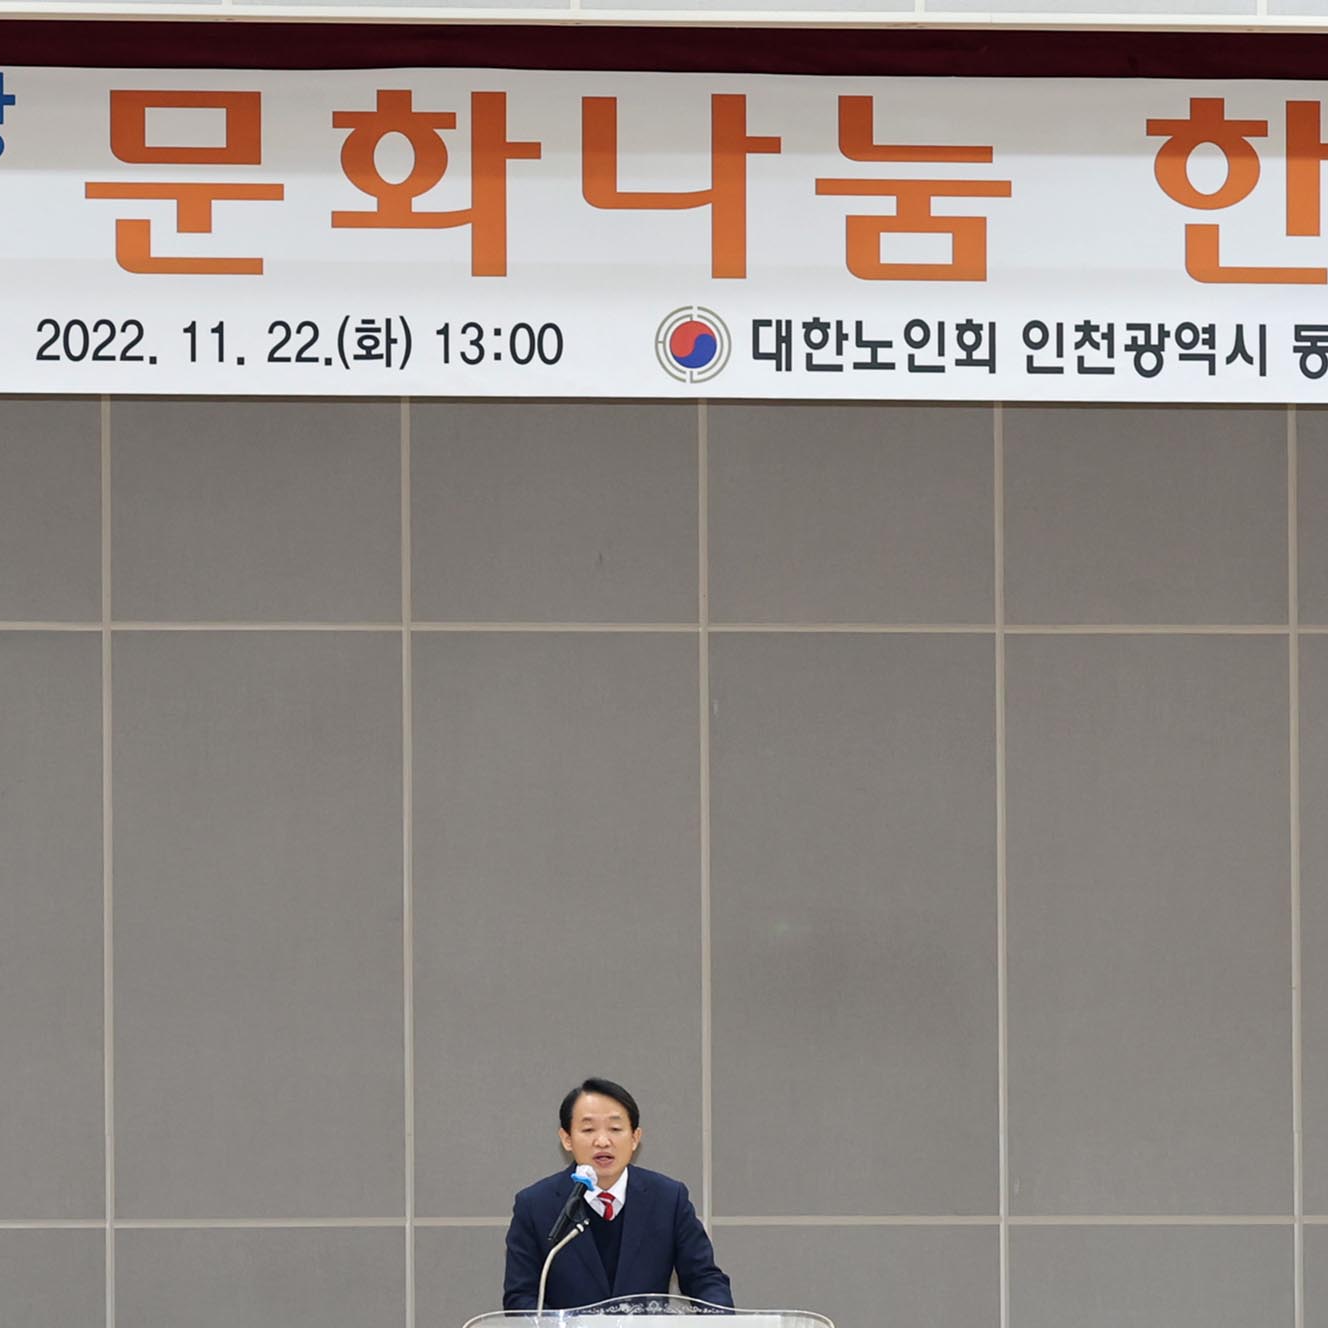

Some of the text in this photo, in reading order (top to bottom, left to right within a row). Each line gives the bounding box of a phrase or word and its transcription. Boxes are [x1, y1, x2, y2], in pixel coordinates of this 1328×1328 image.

[84, 89, 1012, 282] 문화나눔
[36, 316, 564, 370] 2022. 11. 22.(화) 13:00
[751, 317, 997, 376] 대한노인회
[1021, 319, 1268, 379] 인천광역시
